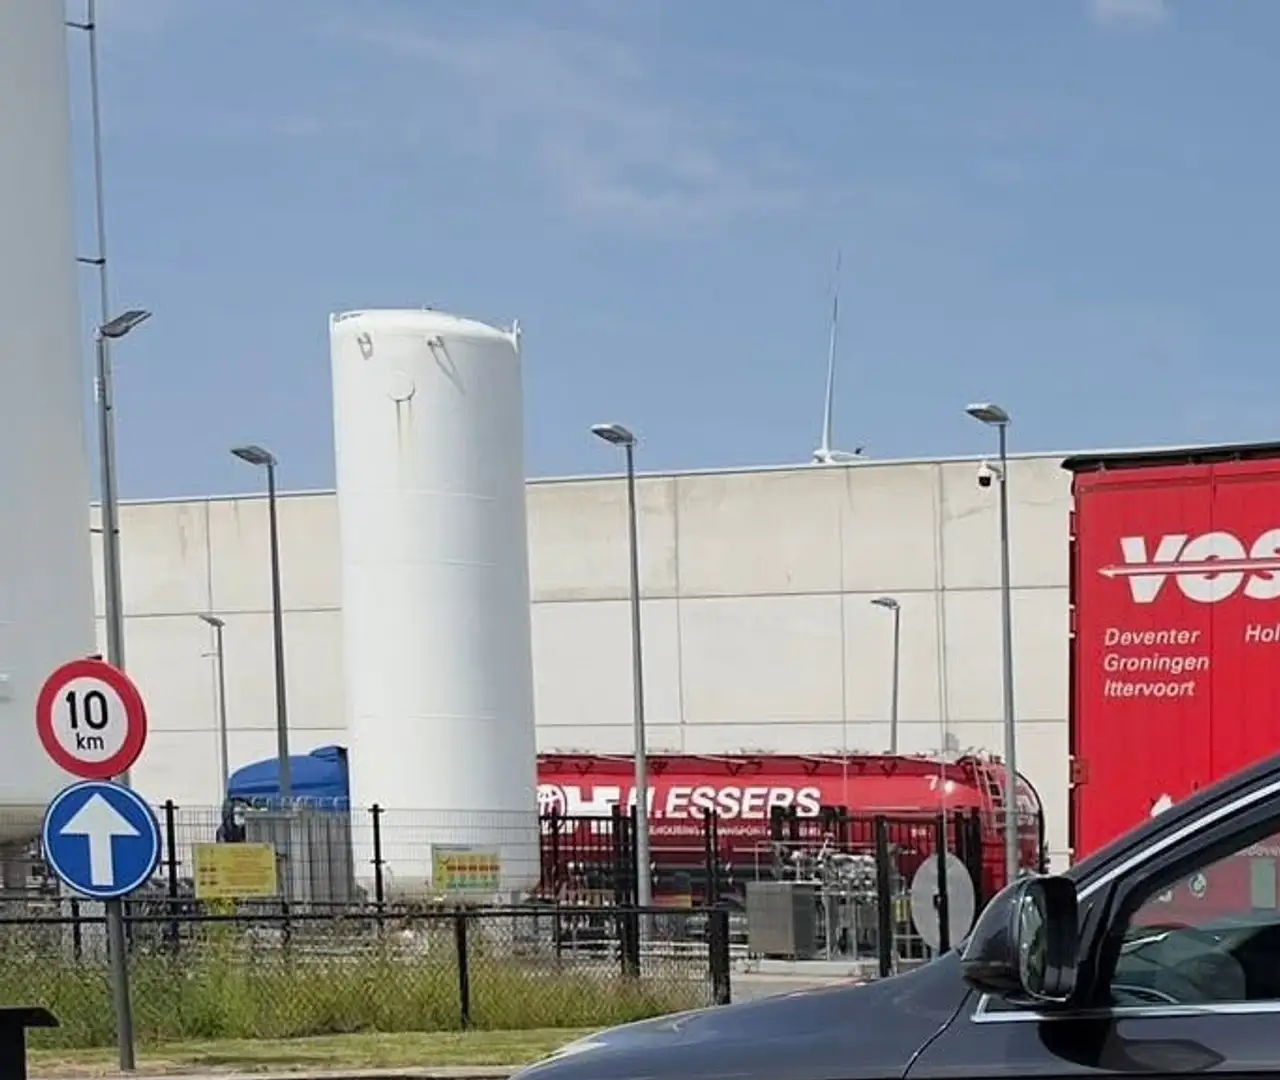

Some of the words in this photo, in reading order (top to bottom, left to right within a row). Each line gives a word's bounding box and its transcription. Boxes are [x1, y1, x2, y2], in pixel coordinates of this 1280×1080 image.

[1104, 627, 1201, 646] Deventer
[1103, 652, 1209, 674] Groningen
[1104, 679, 1196, 697] Ittervoort
[65, 690, 108, 730] 10
[75, 731, 104, 750] km
